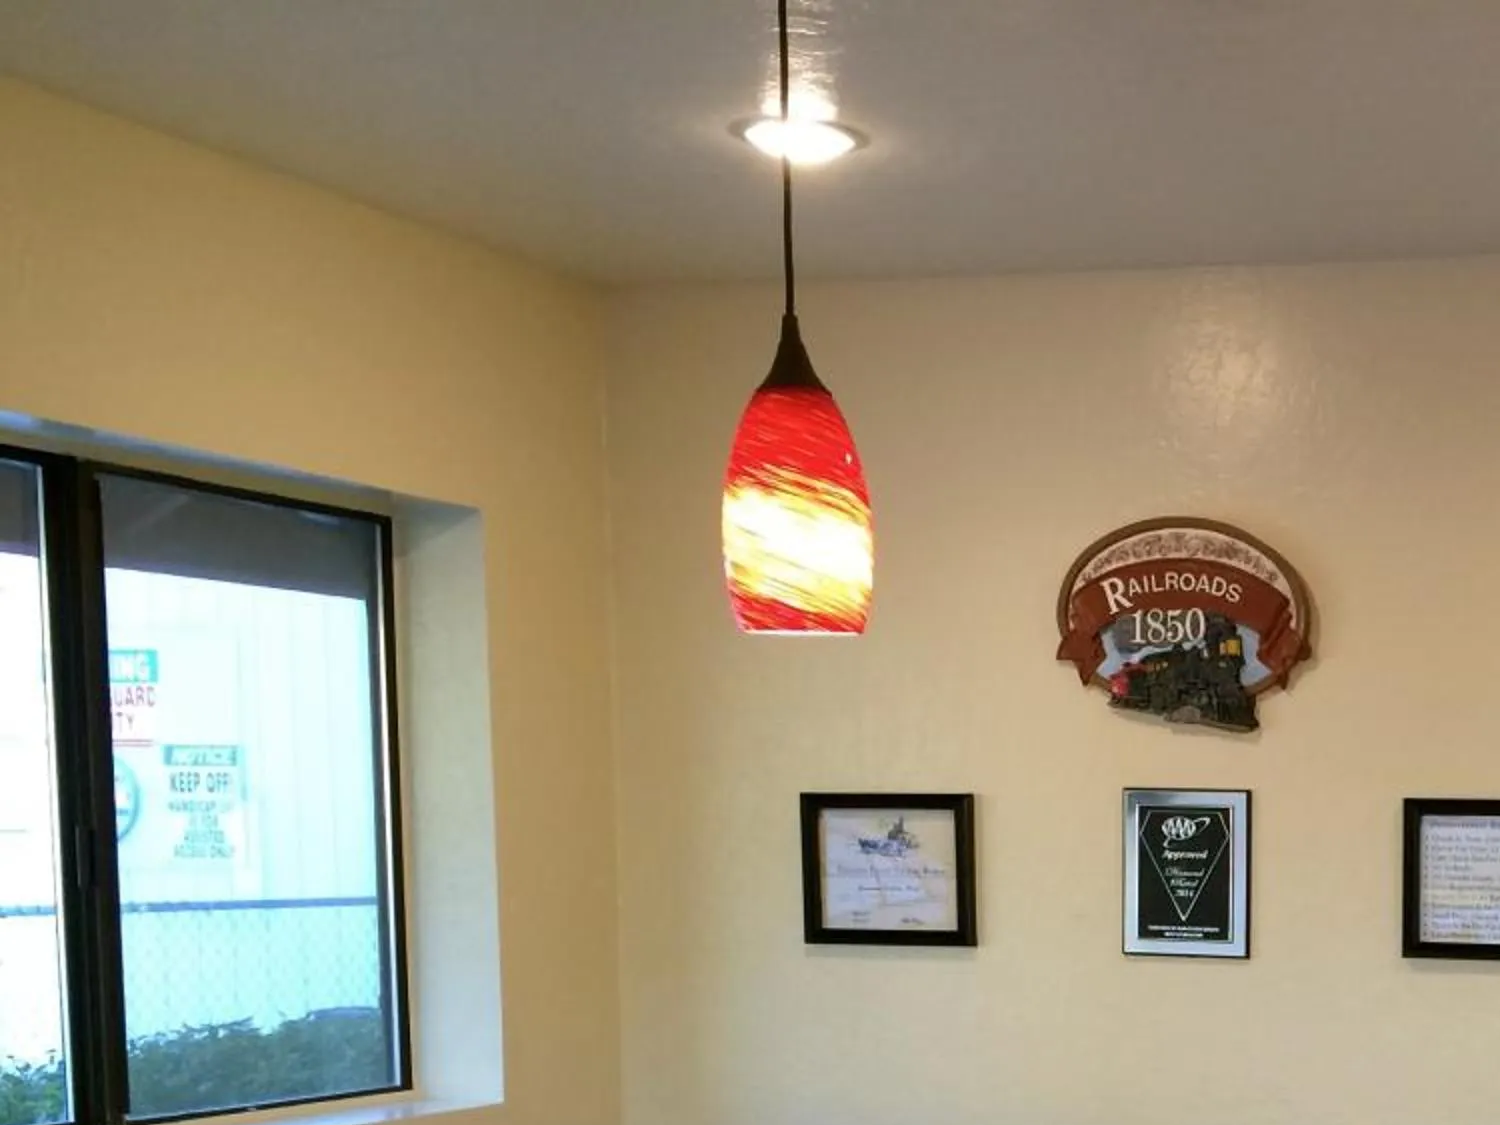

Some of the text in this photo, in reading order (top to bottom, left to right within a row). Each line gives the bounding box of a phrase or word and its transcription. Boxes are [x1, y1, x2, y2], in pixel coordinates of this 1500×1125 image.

[1100, 571, 1243, 615] RAILROADS
[1129, 608, 1206, 644] 1850
[169, 771, 201, 793] KEEP
